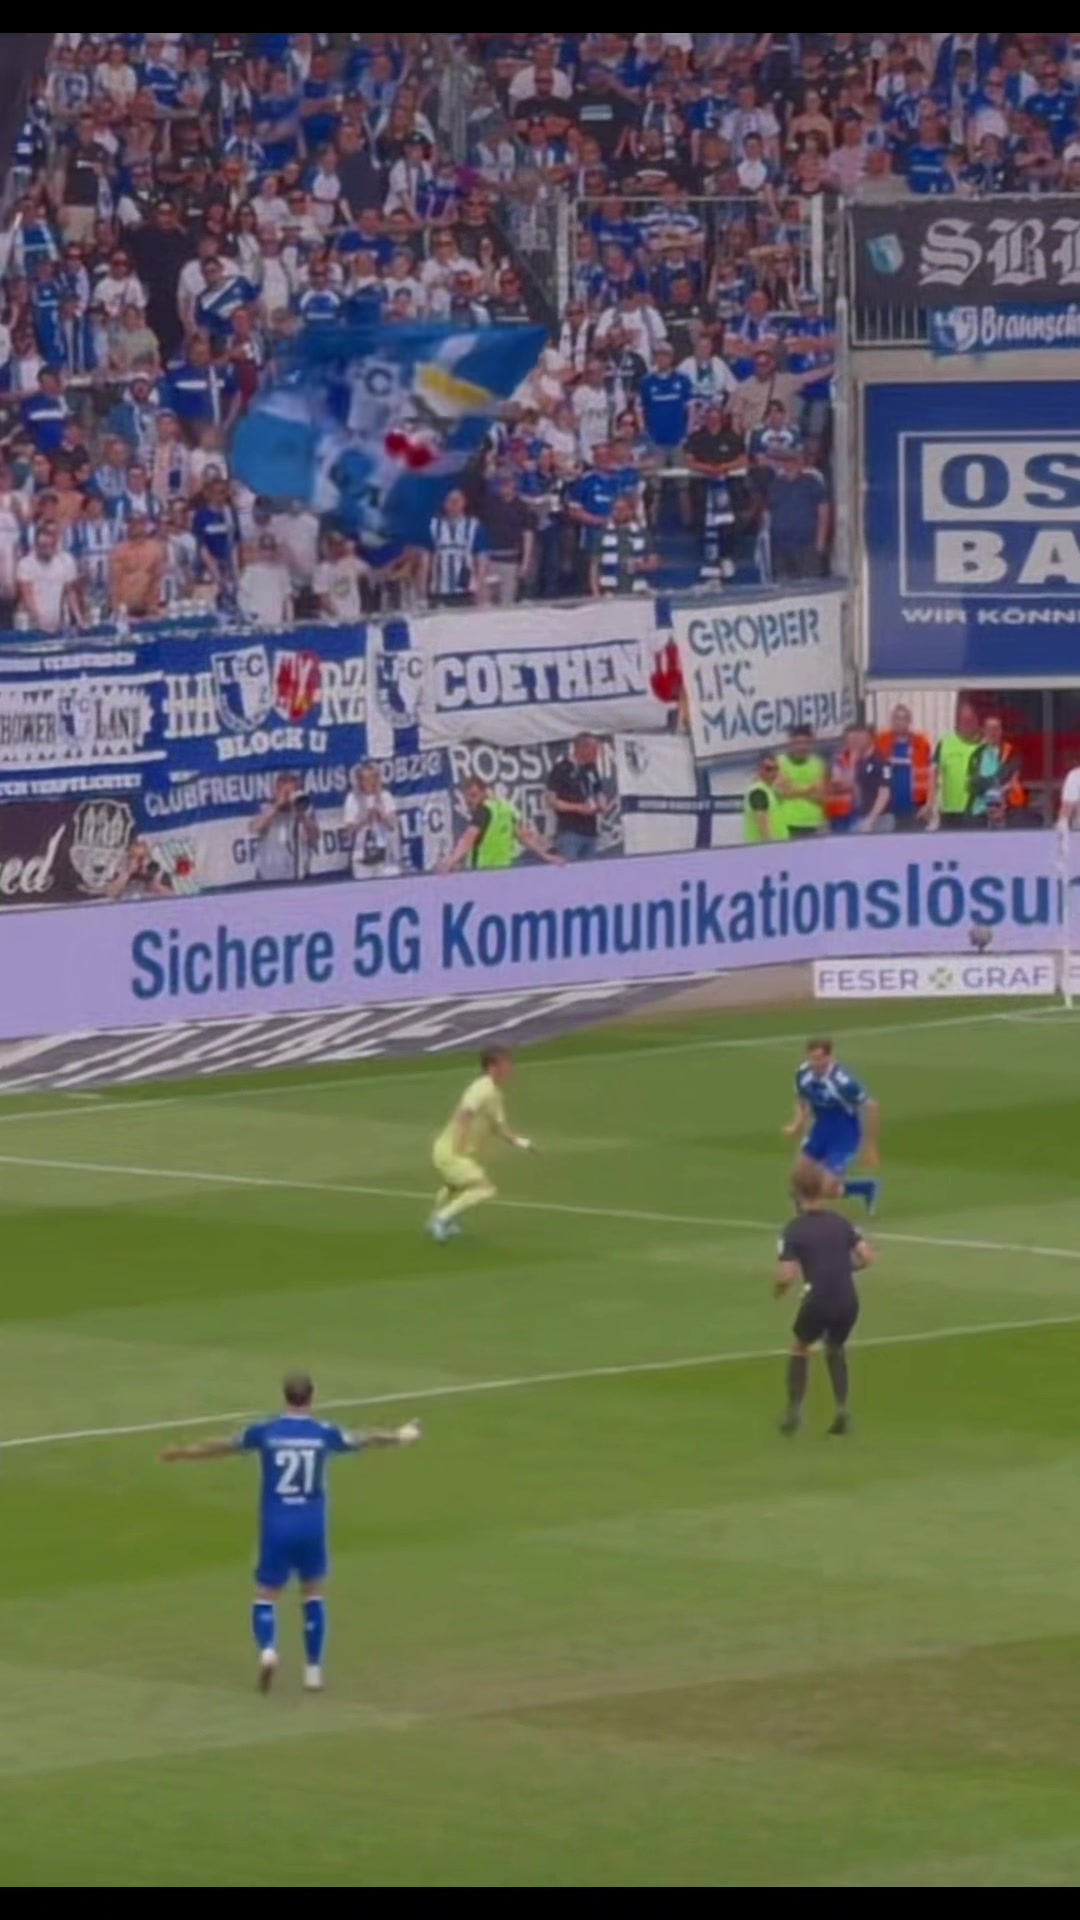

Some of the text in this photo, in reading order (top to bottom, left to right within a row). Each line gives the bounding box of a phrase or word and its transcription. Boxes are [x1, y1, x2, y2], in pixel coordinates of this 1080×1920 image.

[941, 453, 1080, 510] OS
[977, 604, 1080, 626] KÖNN
[435, 645, 641, 708] COETHEN
[216, 725, 329, 760] BLOCK U
[303, 764, 348, 796] AUS
[131, 925, 335, 1000] Sichere
[353, 905, 421, 978] 5G
[818, 968, 919, 992] FESER
[961, 965, 1050, 989] GRAF
[275, 1449, 315, 1494] 21
